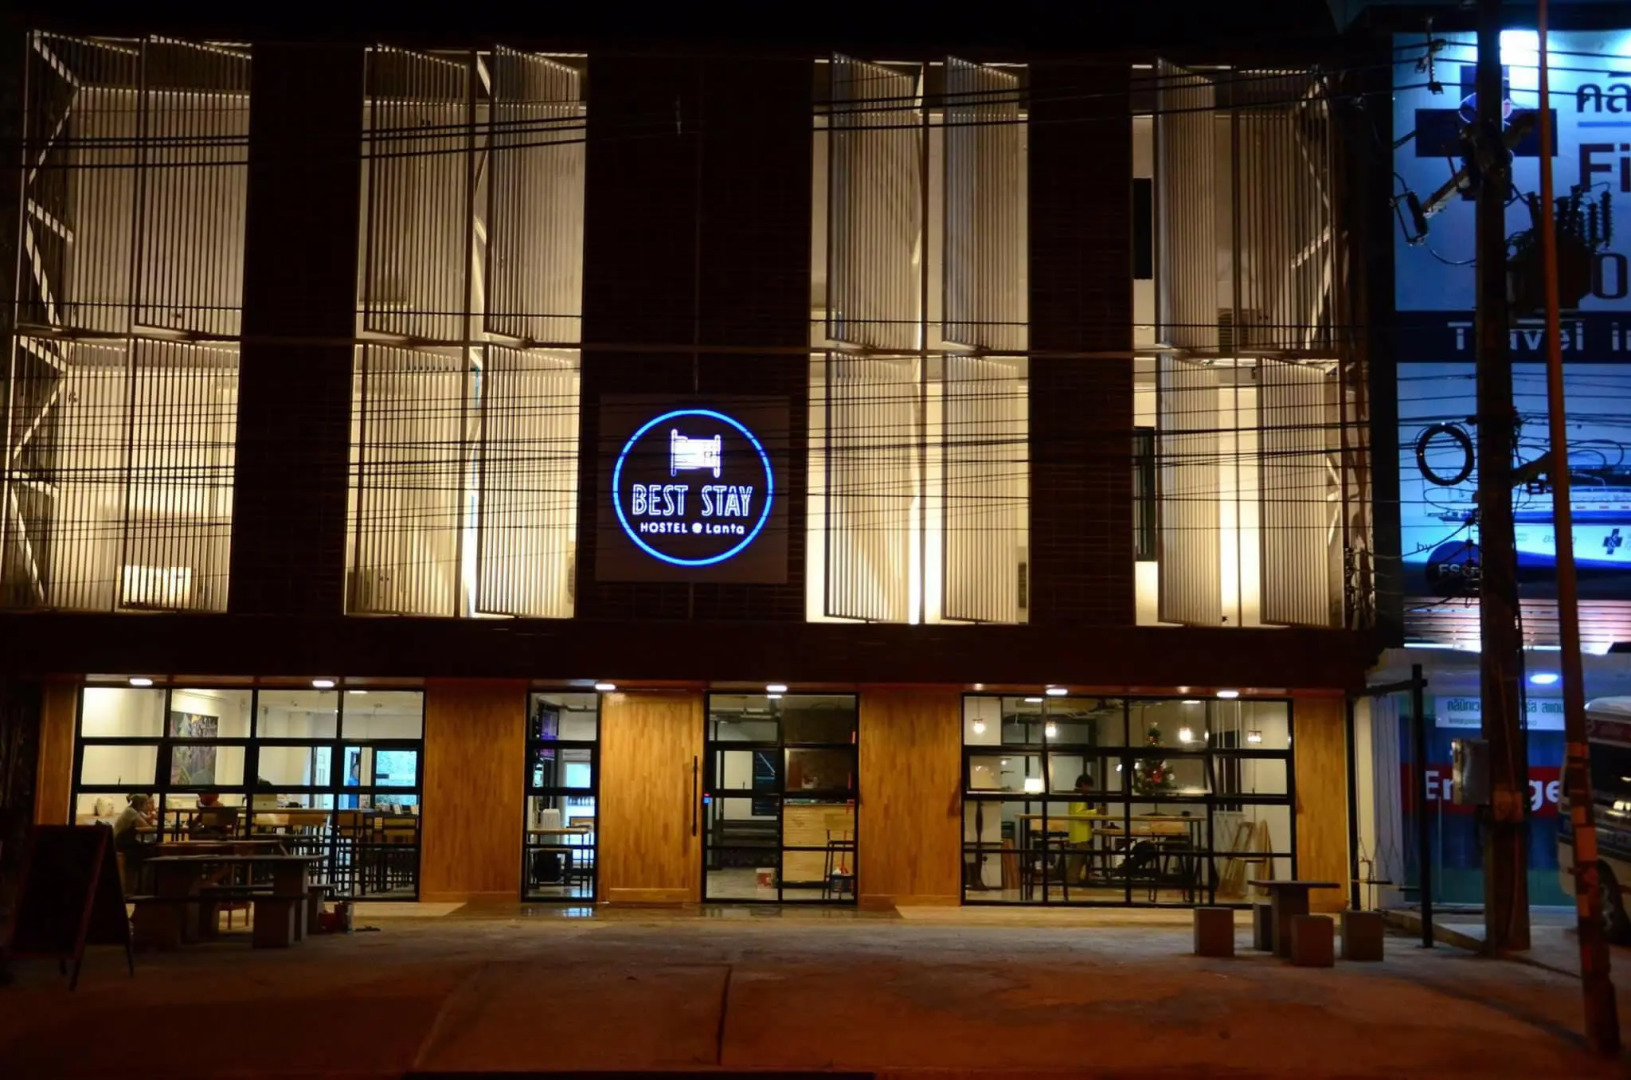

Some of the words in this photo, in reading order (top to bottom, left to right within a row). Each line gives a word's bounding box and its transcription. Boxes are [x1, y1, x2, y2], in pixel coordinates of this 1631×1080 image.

[632, 483, 689, 517] BEST
[701, 485, 753, 517] STAY
[640, 522, 688, 534] HOSTEL
[706, 522, 745, 535] Lanta
